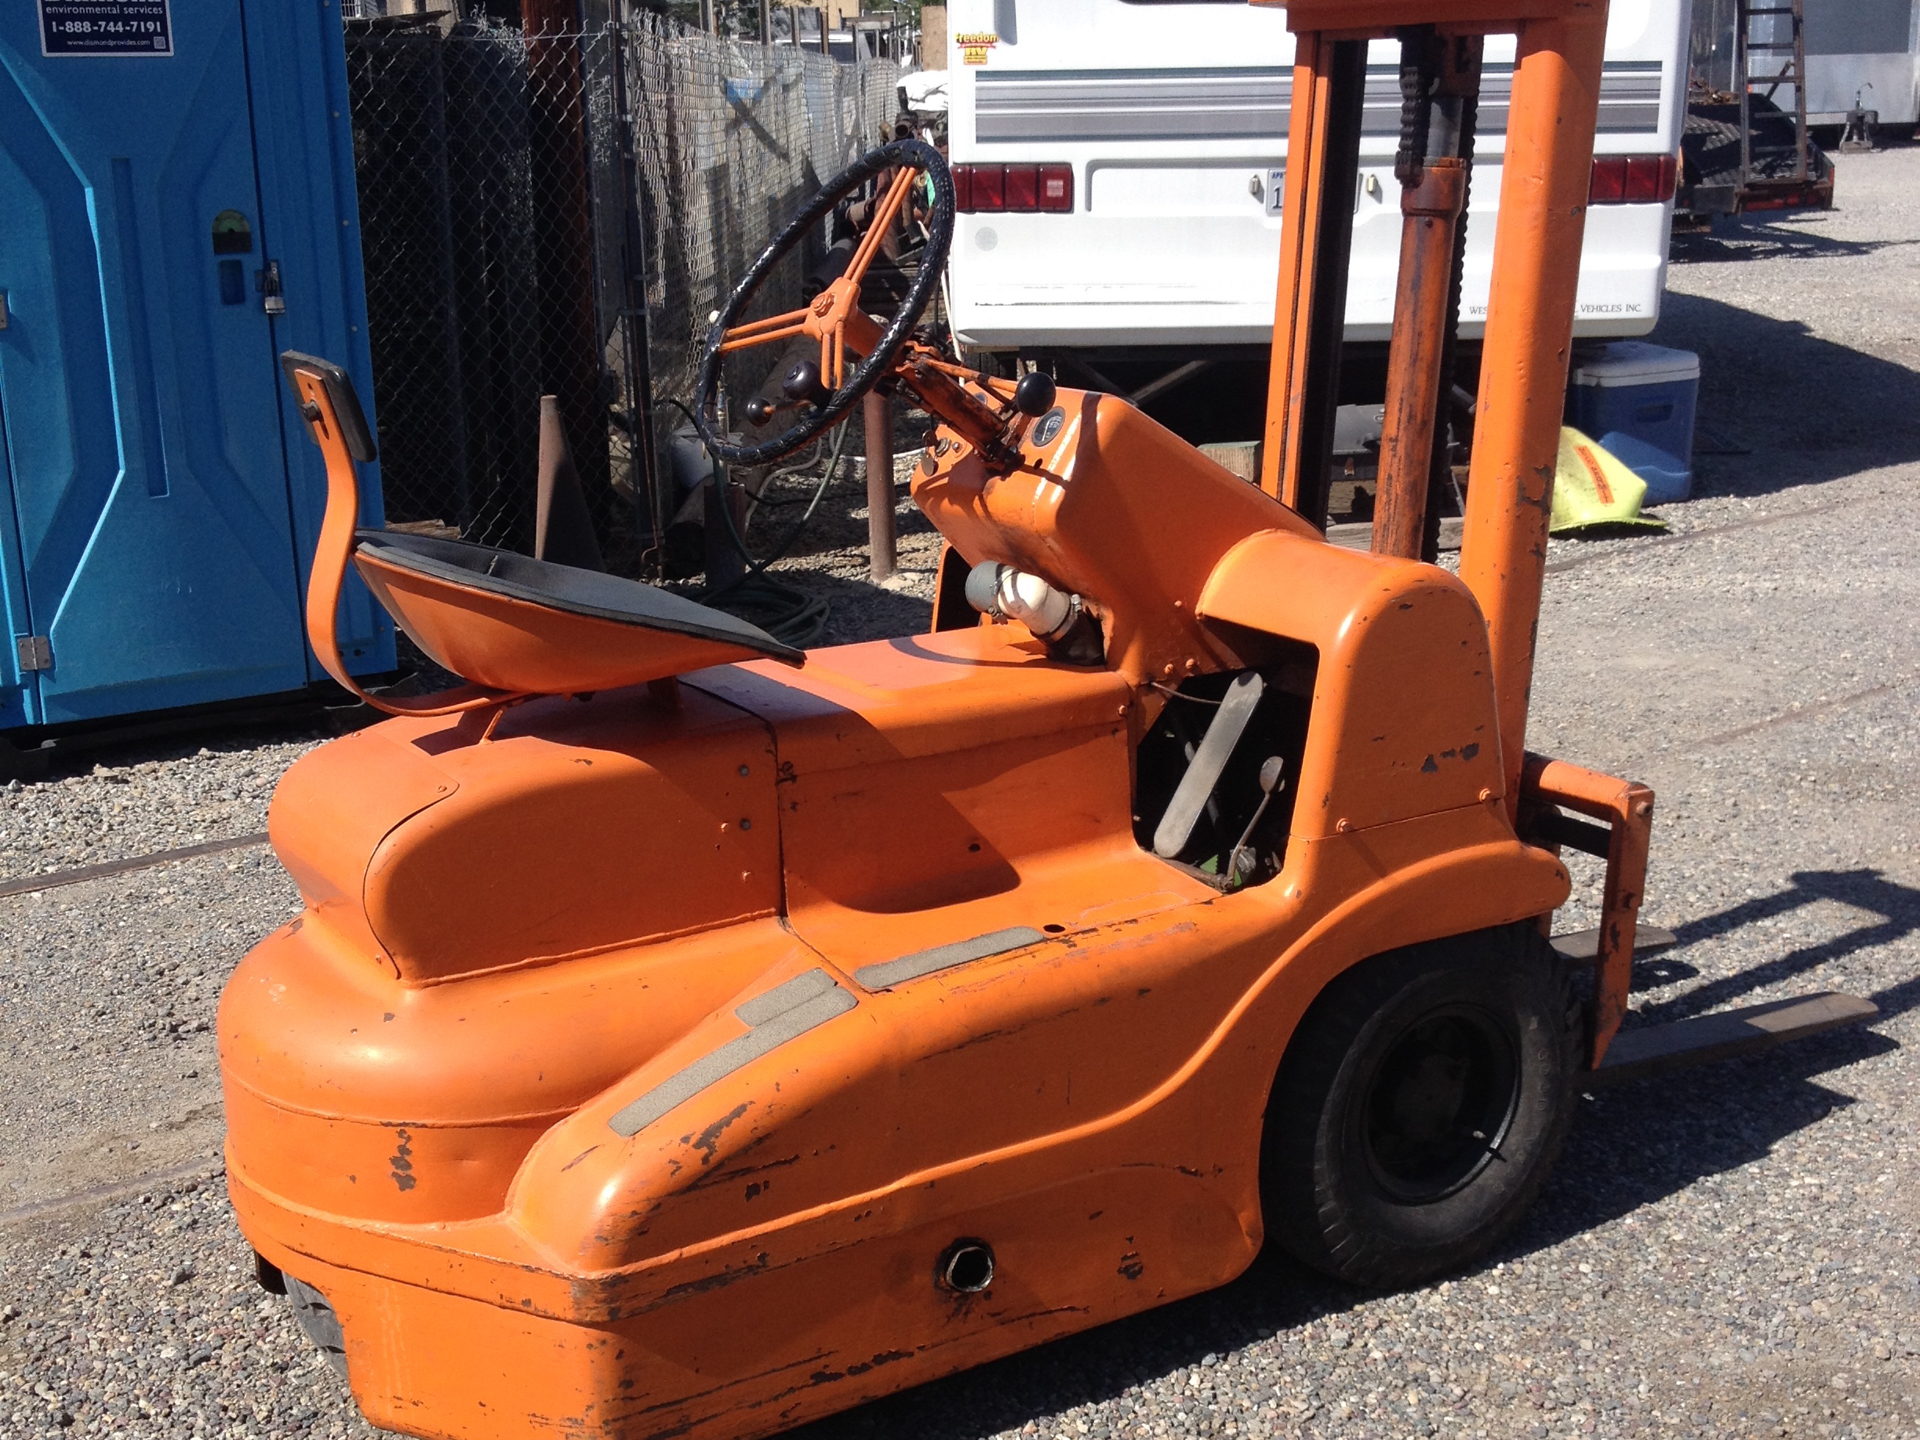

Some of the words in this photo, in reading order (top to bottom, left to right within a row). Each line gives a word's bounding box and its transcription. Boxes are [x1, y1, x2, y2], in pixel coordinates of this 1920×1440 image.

[46, 4, 120, 14] environmental
[123, 6, 163, 14] services
[51, 21, 161, 33] 1-888-744-7191
[1580, 304, 1622, 313] VEHICLES
